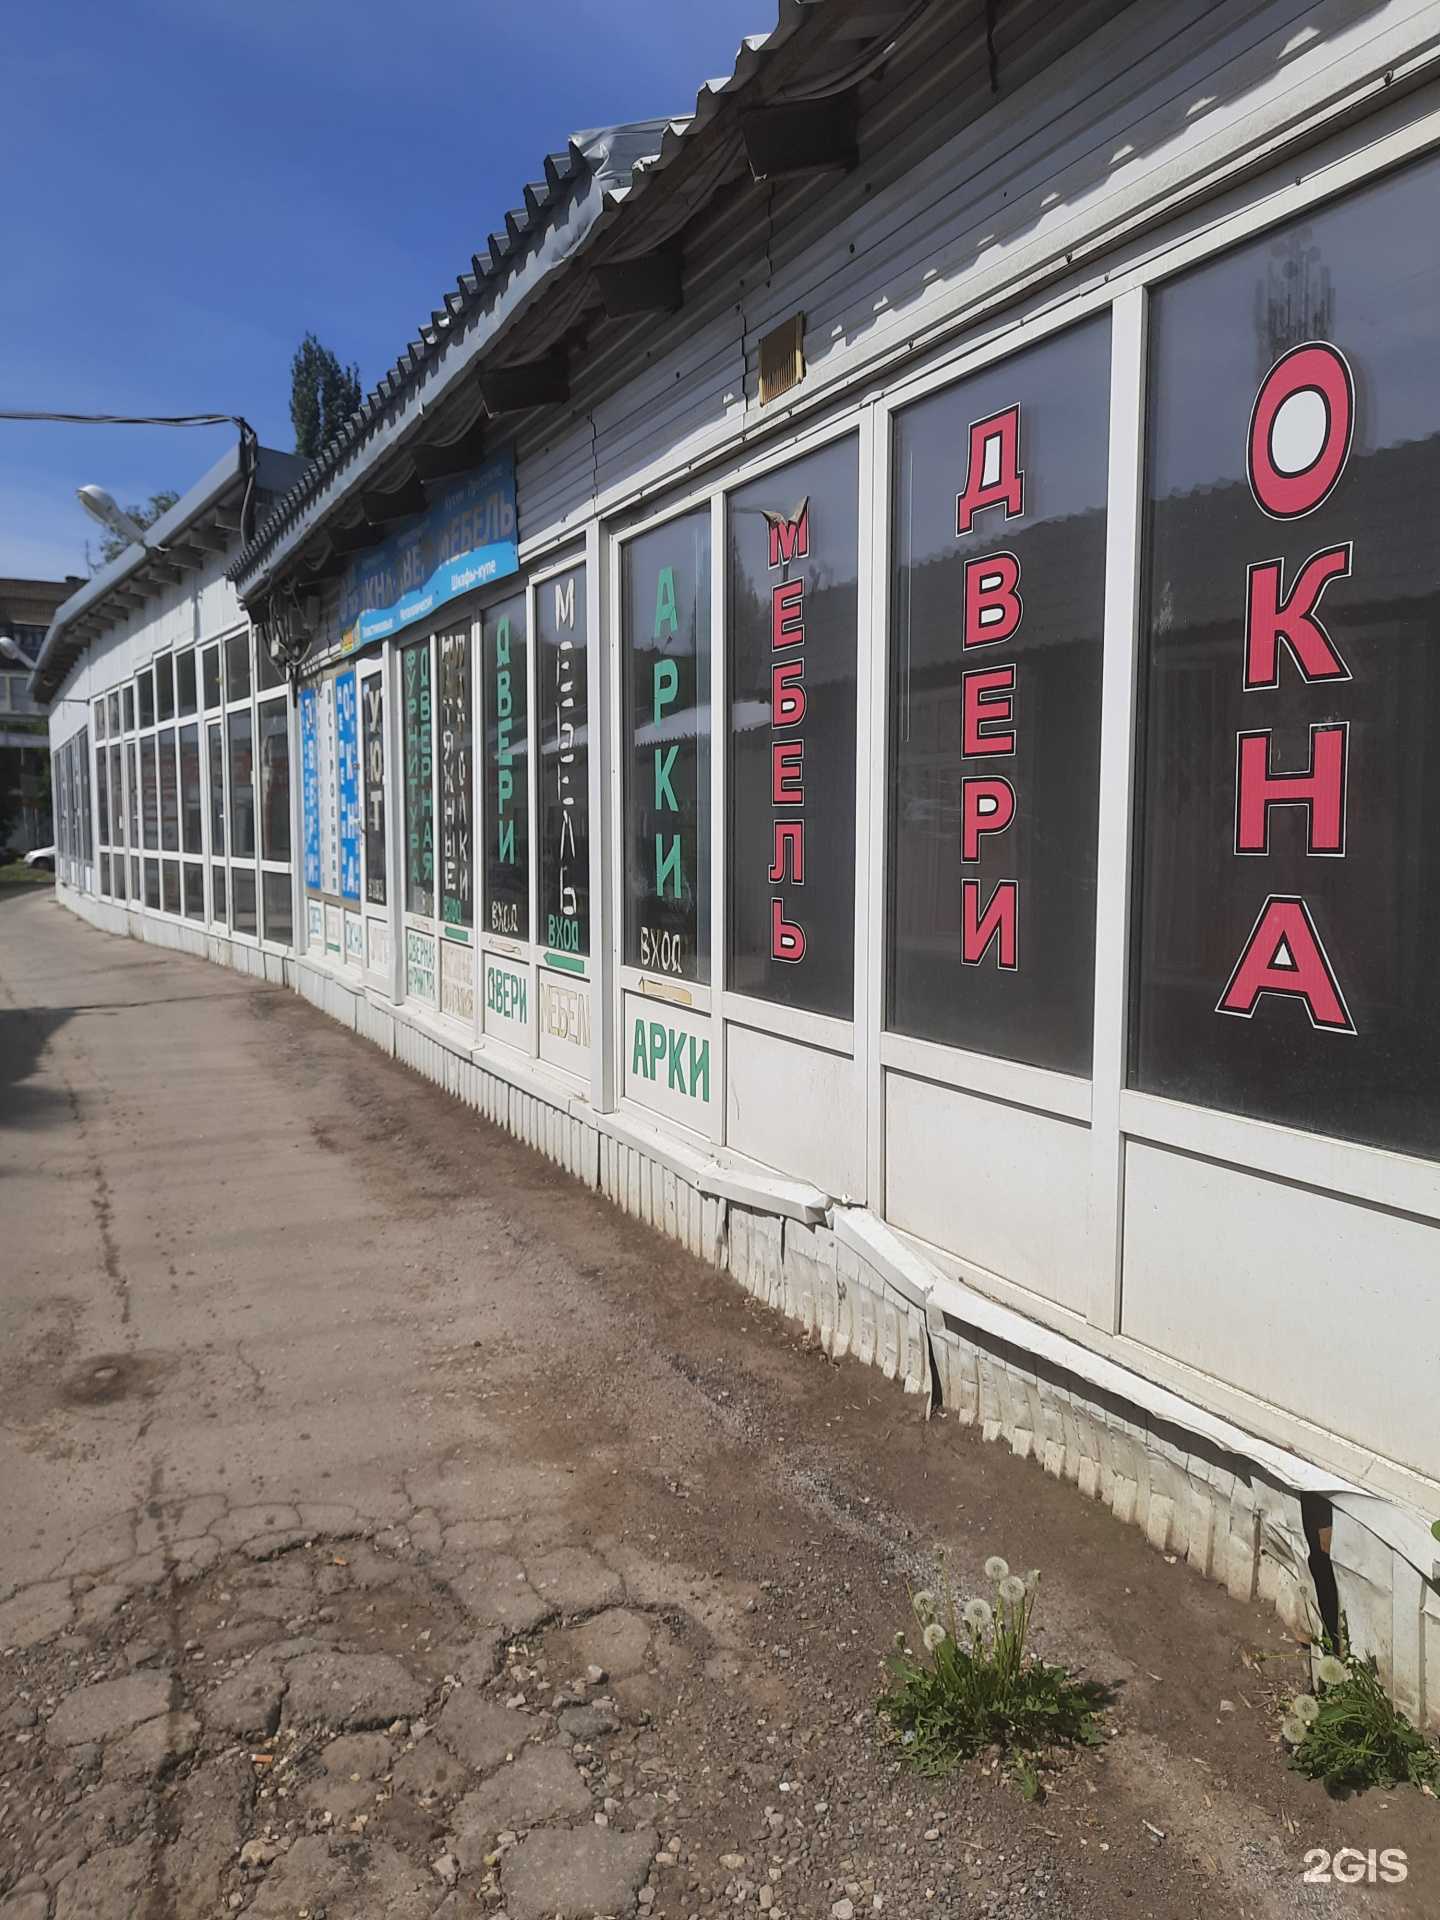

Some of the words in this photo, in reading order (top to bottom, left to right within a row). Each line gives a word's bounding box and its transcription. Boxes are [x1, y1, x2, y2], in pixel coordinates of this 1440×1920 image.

[369, 689, 383, 832] УЮТ
[406, 649, 420, 883] ФУРНИТУРА
[420, 647, 434, 881] ДВЕРНАЯ
[497, 616, 515, 865] ДВЕРИ
[653, 565, 682, 899] АРКИ
[761, 496, 811, 965] МЕБЕЛЬ
[954, 402, 1026, 973] ДВЕРИ
[1215, 339, 1359, 1036] ОКНА
[487, 966, 528, 1025] ДВЕРИ
[491, 901, 519, 933] ВХОД
[548, 914, 579, 952] ВХОД
[640, 926, 683, 974] ВХОД
[632, 1018, 710, 1103] АРКИ
